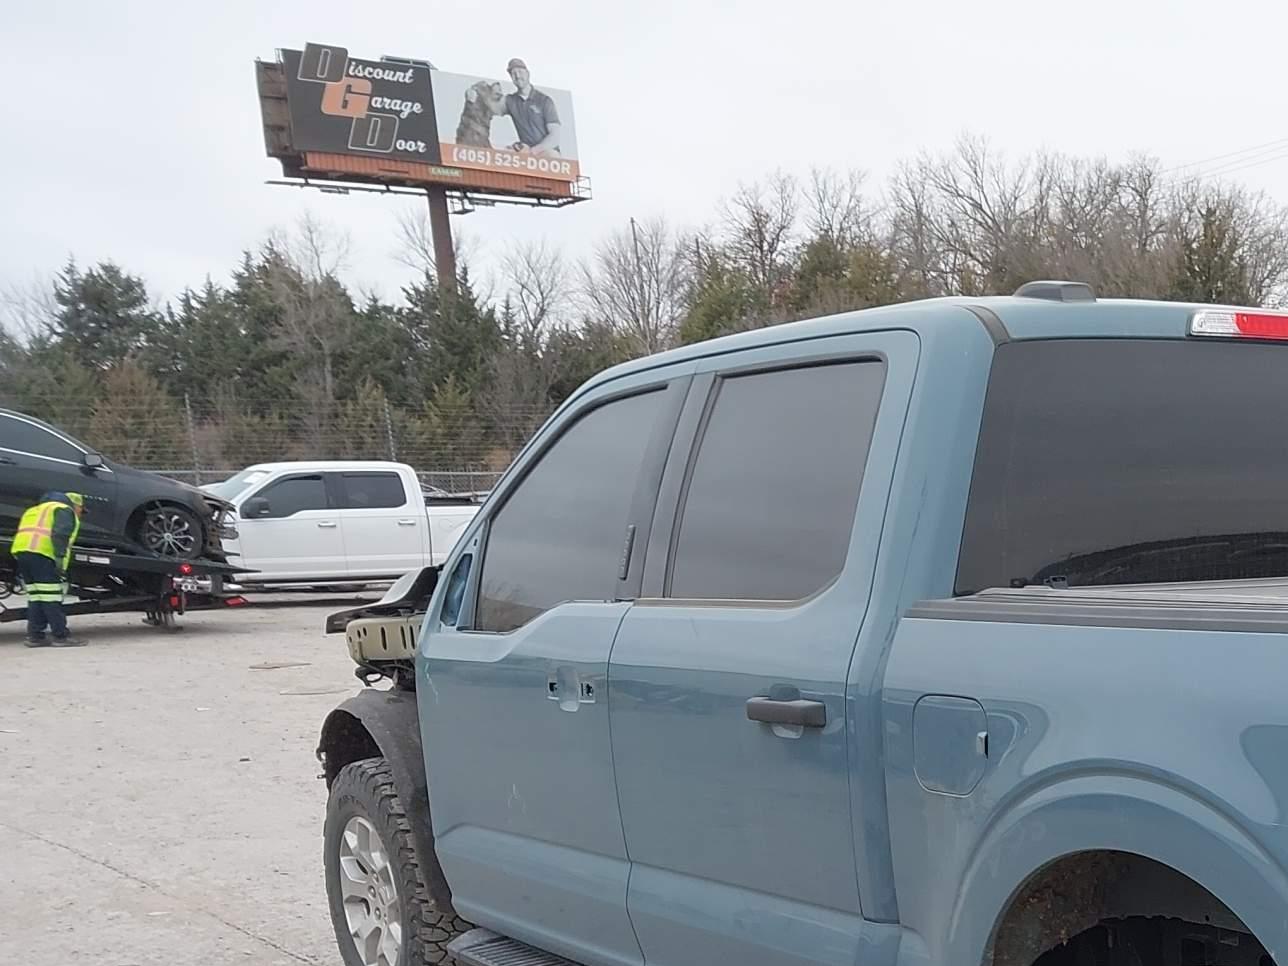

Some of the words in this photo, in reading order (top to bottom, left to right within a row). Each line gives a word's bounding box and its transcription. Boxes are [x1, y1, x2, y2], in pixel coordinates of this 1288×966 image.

[297, 42, 414, 84] Discount
[321, 77, 423, 118] Garage
[348, 112, 427, 153] Door
[453, 147, 490, 166] (405)
[495, 153, 571, 174] 525-DOOR
